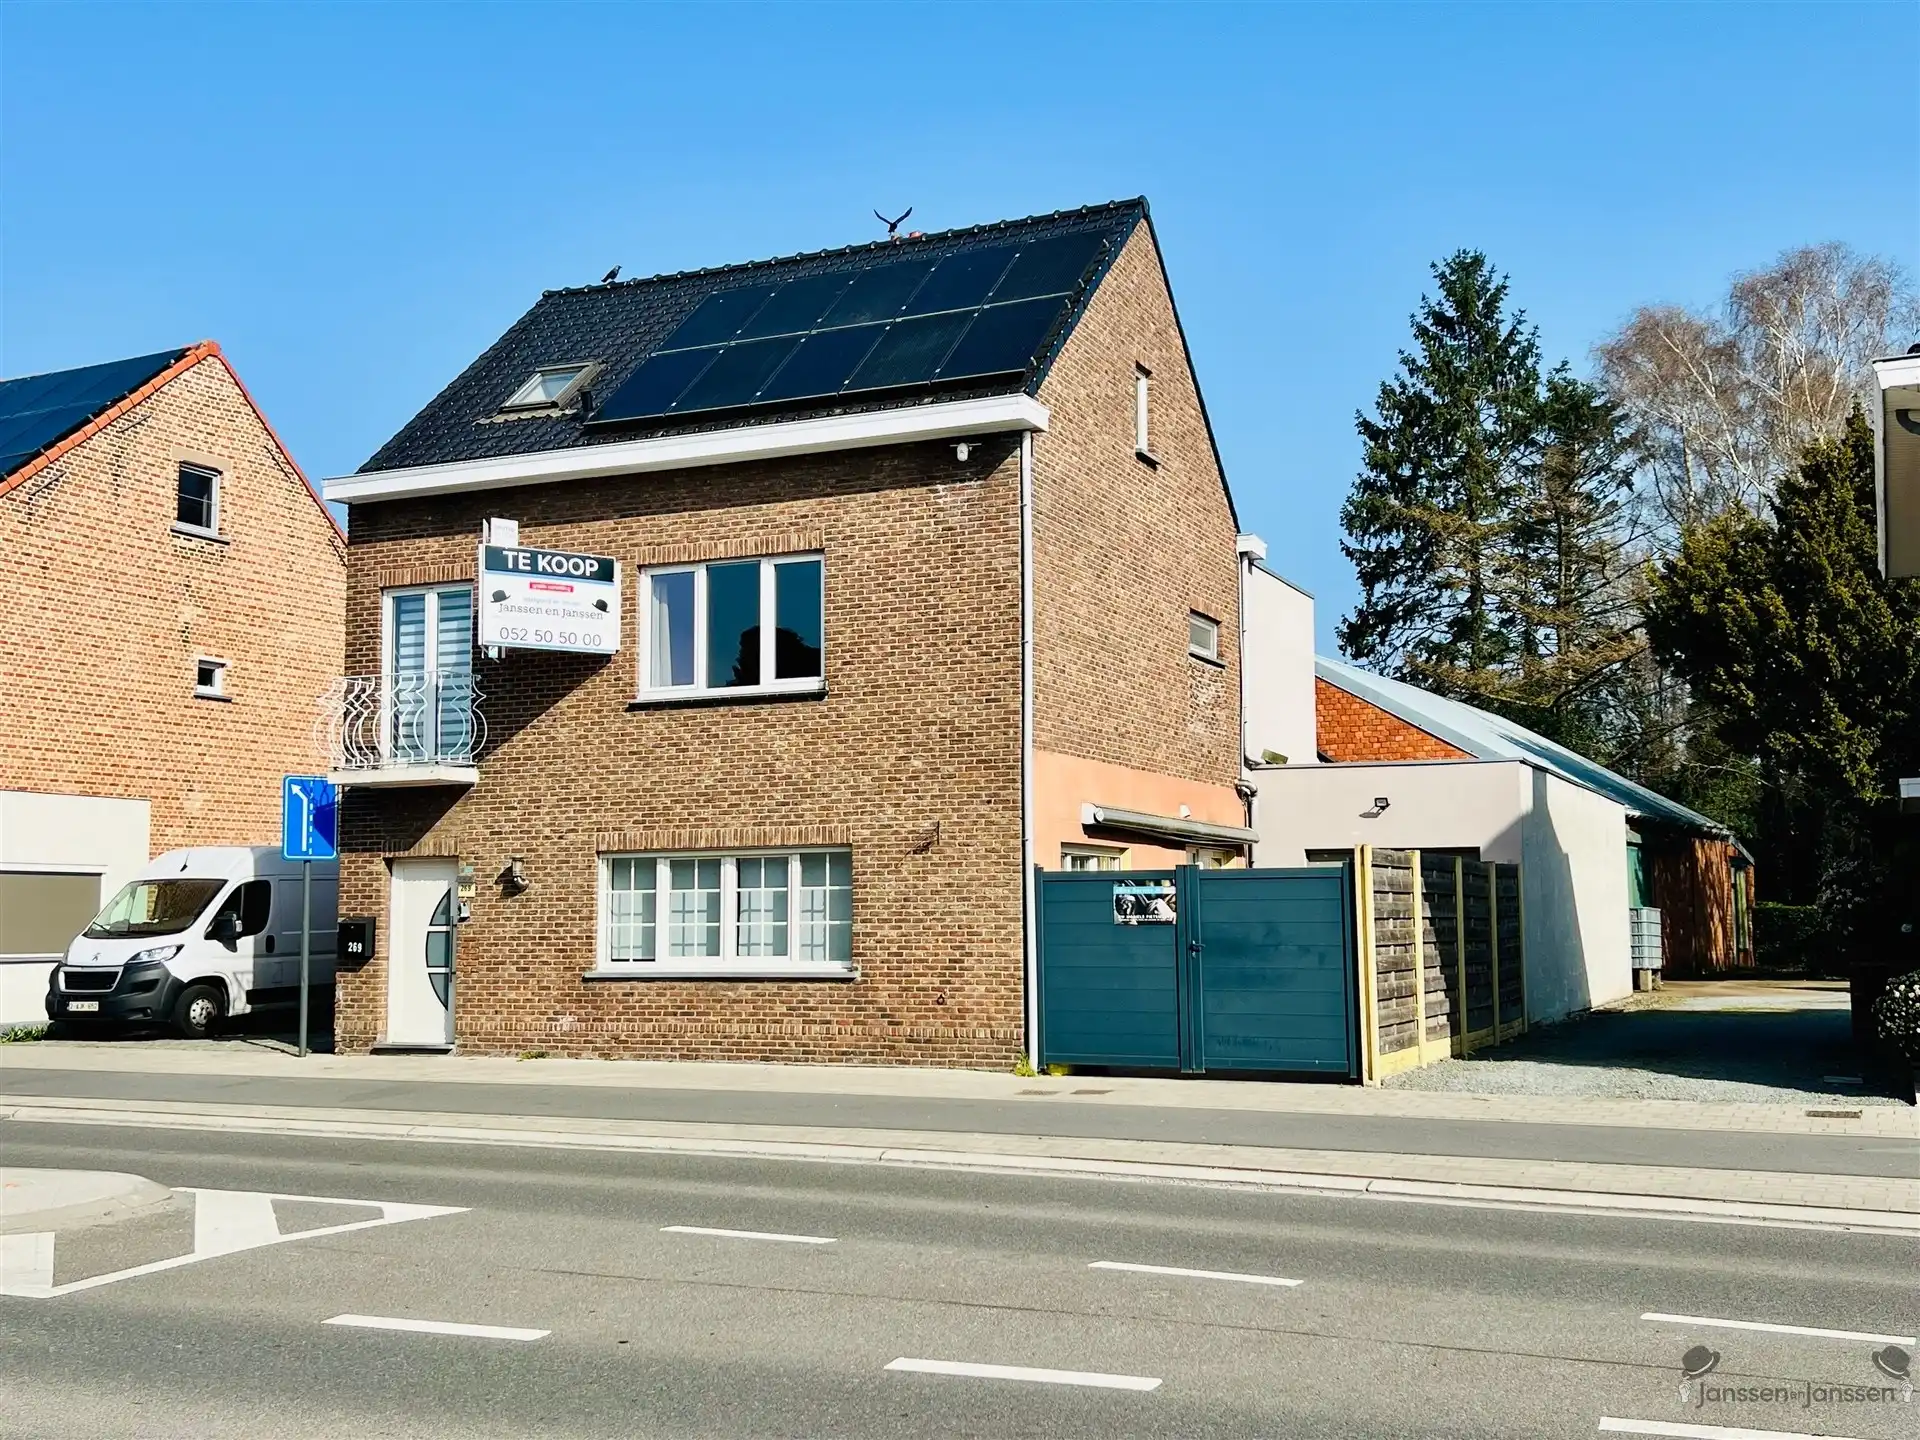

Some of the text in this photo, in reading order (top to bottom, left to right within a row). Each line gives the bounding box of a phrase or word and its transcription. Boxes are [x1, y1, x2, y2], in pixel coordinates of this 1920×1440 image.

[502, 550, 599, 577] TE KOOP
[499, 603, 604, 620] Janssen en Janssen
[500, 627, 602, 646] 052 50 50 00
[347, 942, 362, 953] 269
